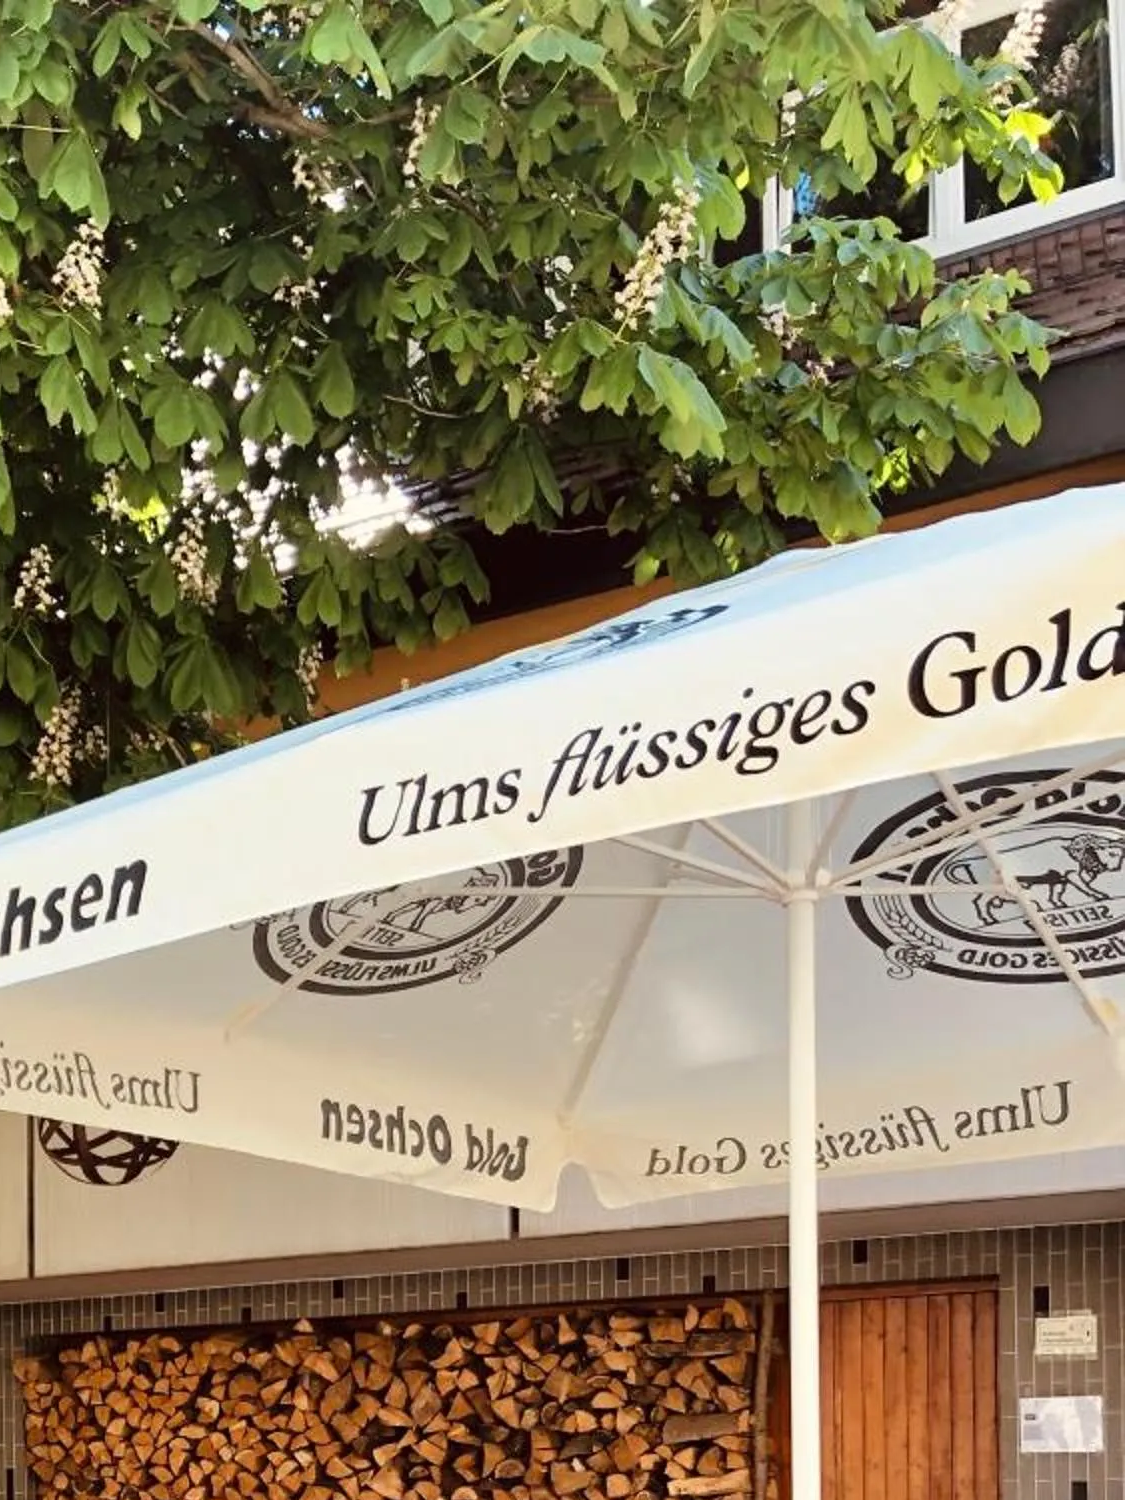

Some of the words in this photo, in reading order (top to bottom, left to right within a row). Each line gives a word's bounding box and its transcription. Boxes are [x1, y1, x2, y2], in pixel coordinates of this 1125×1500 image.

[356, 764, 522, 847] Ulms
[527, 678, 877, 823] flüssiges
[908, 601, 1125, 719] Gold
